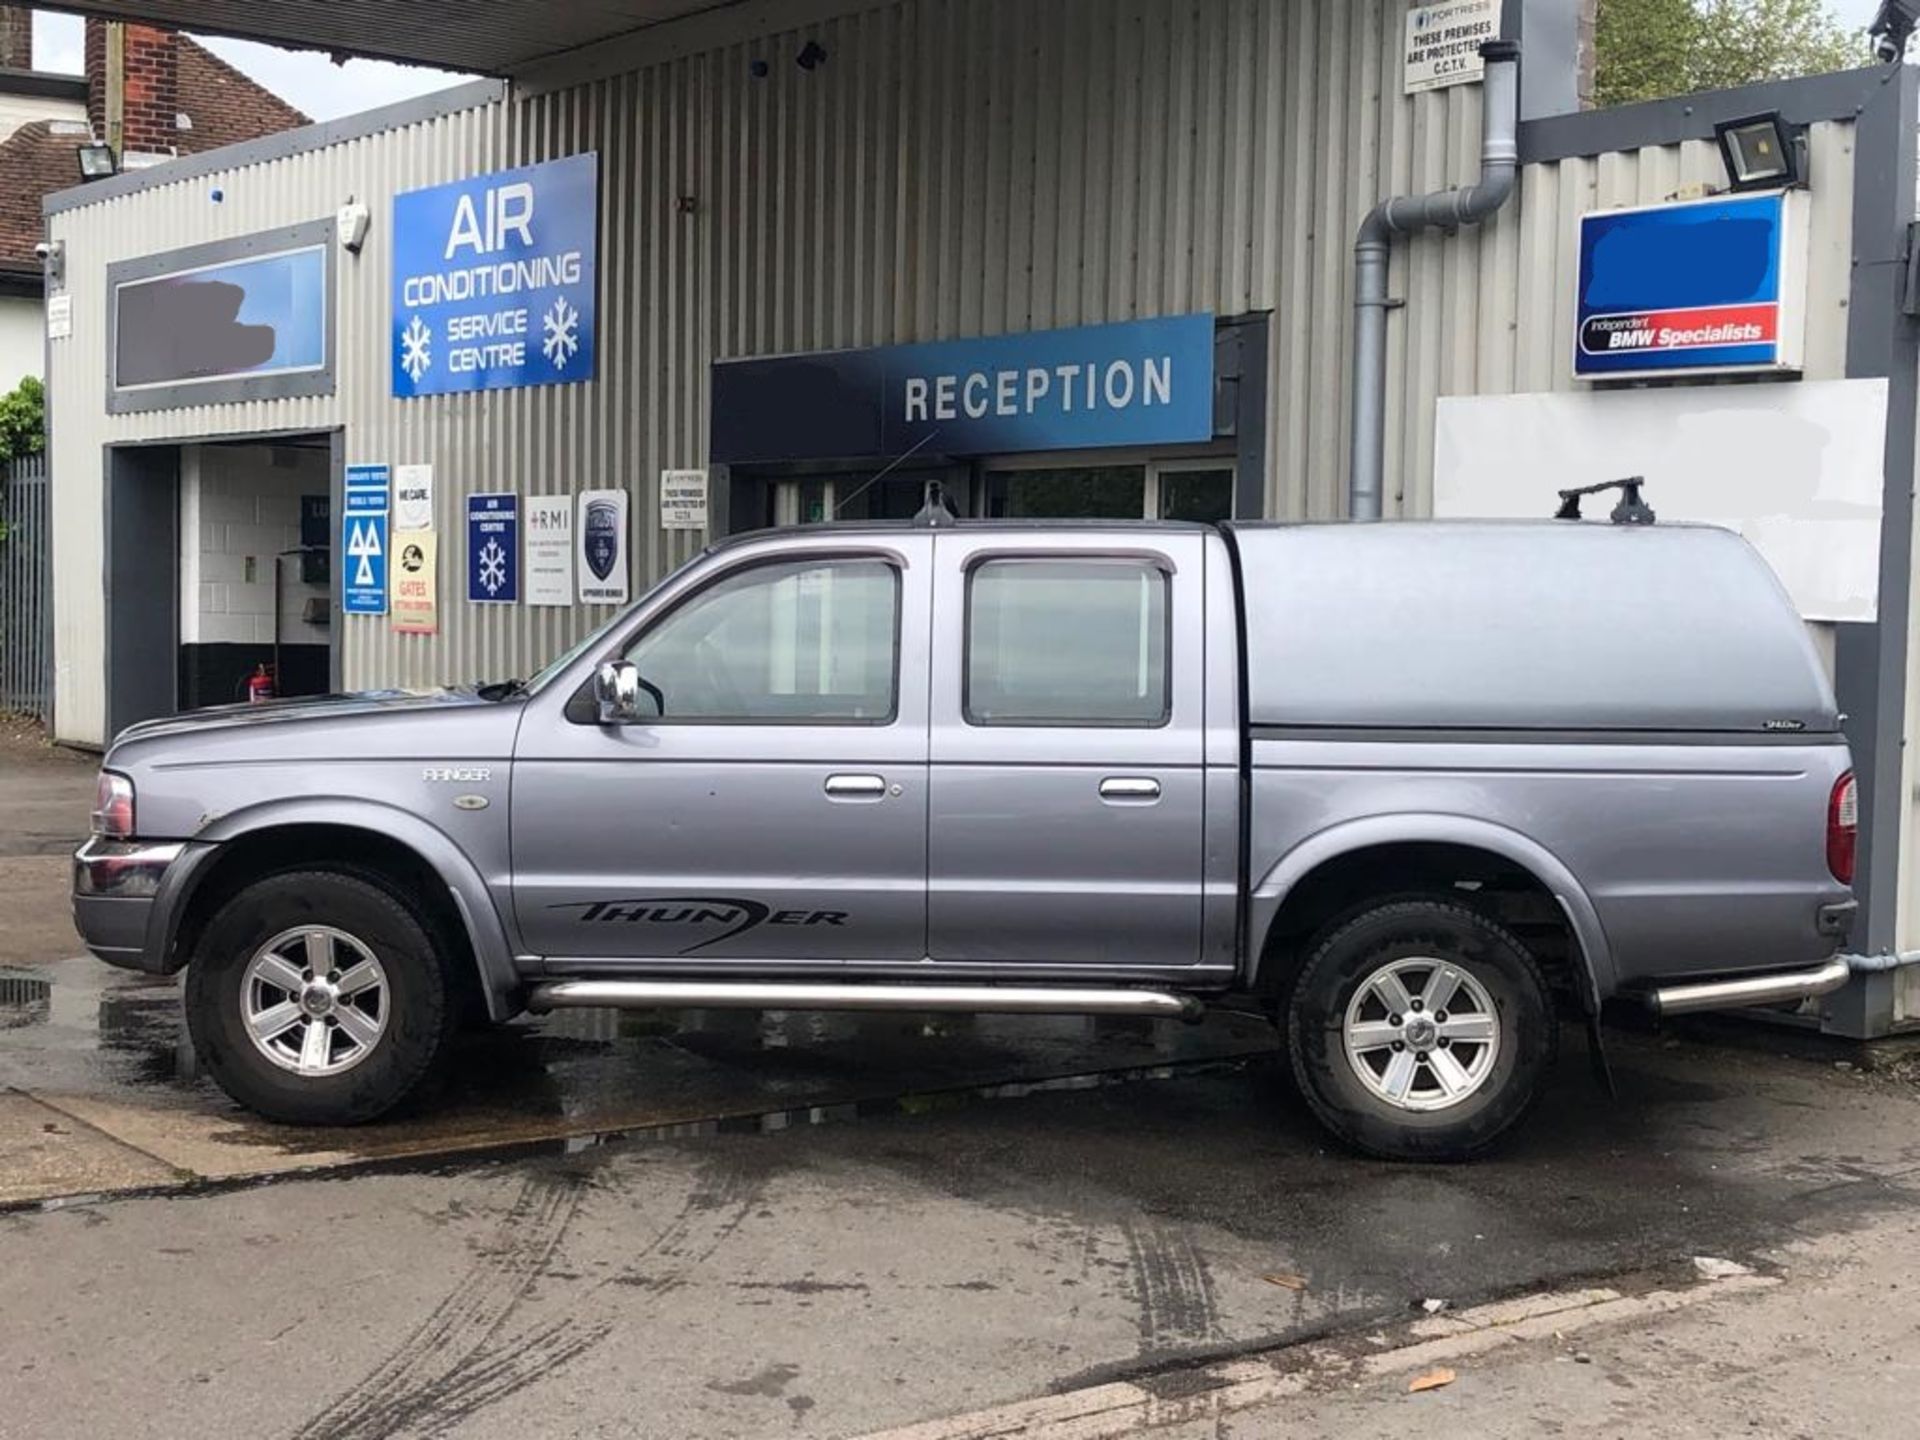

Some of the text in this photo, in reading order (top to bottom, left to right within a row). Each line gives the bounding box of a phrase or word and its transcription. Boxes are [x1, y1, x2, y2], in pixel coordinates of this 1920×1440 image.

[1413, 31, 1442, 47] THESE
[1444, 20, 1492, 39] PREMISES
[1407, 49, 1425, 64] ARE
[1426, 39, 1481, 60] PROTECTED
[444, 181, 534, 260] AIR
[404, 252, 581, 307] CONDITIONING
[447, 308, 528, 342] SERVICE
[1590, 317, 1650, 332] Independent
[1608, 323, 1763, 349] BMW Specialists
[448, 342, 526, 373] CENTRE
[905, 356, 1171, 422] RECEPTION
[540, 509, 568, 530] RMI
[422, 767, 491, 781] RANGER
